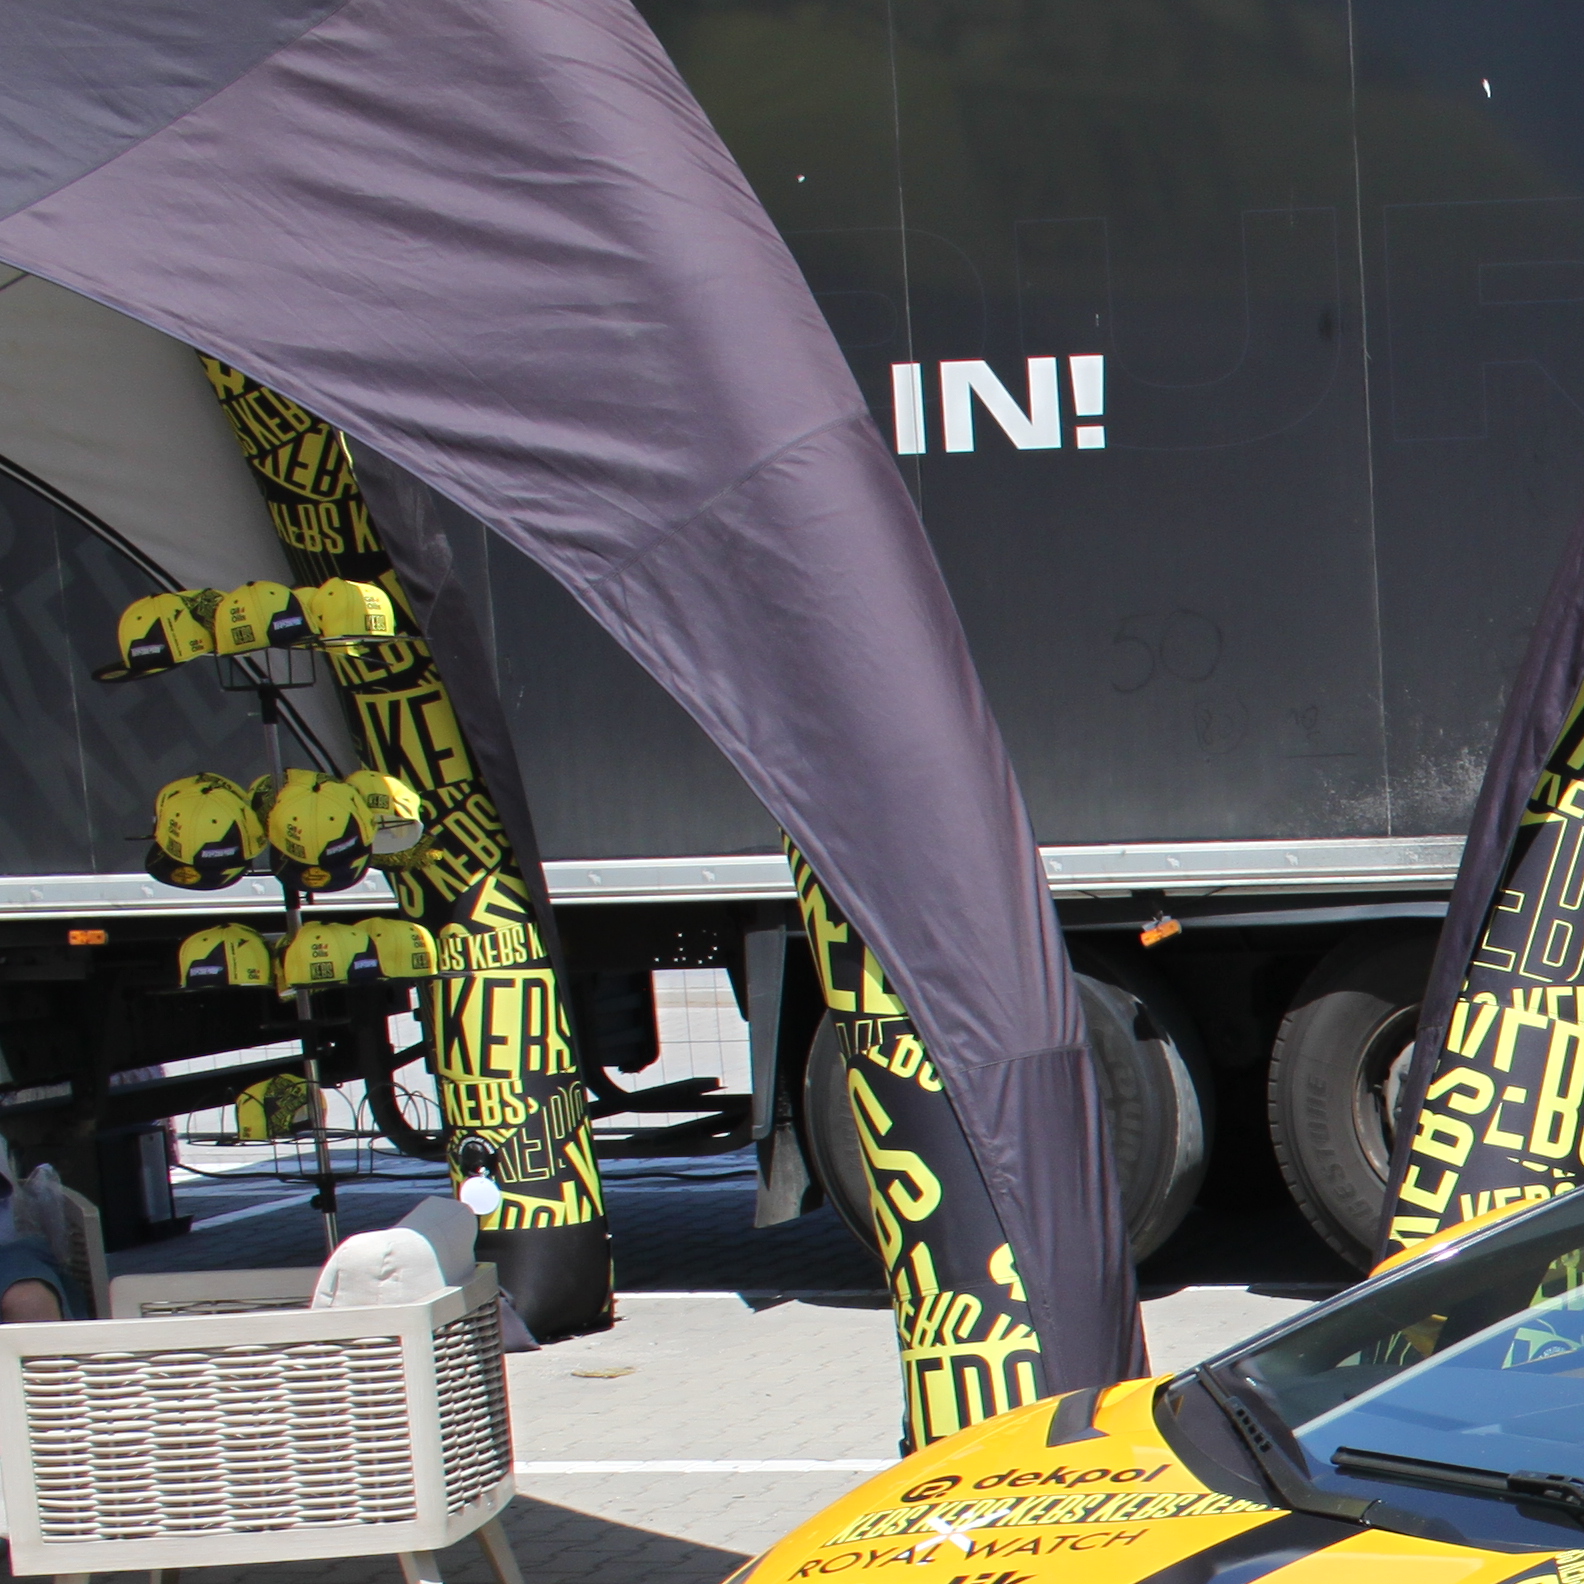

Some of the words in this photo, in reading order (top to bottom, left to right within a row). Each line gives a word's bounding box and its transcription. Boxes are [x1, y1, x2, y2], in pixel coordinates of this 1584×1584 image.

[973, 1464, 1173, 1490] dekpol
[825, 1503, 921, 1548] KEBS
[997, 1494, 1100, 1526] KEBS
[1092, 1492, 1191, 1522] KEBS
[787, 1545, 943, 1582] ROYAL
[962, 1528, 1149, 1562] WATCH
